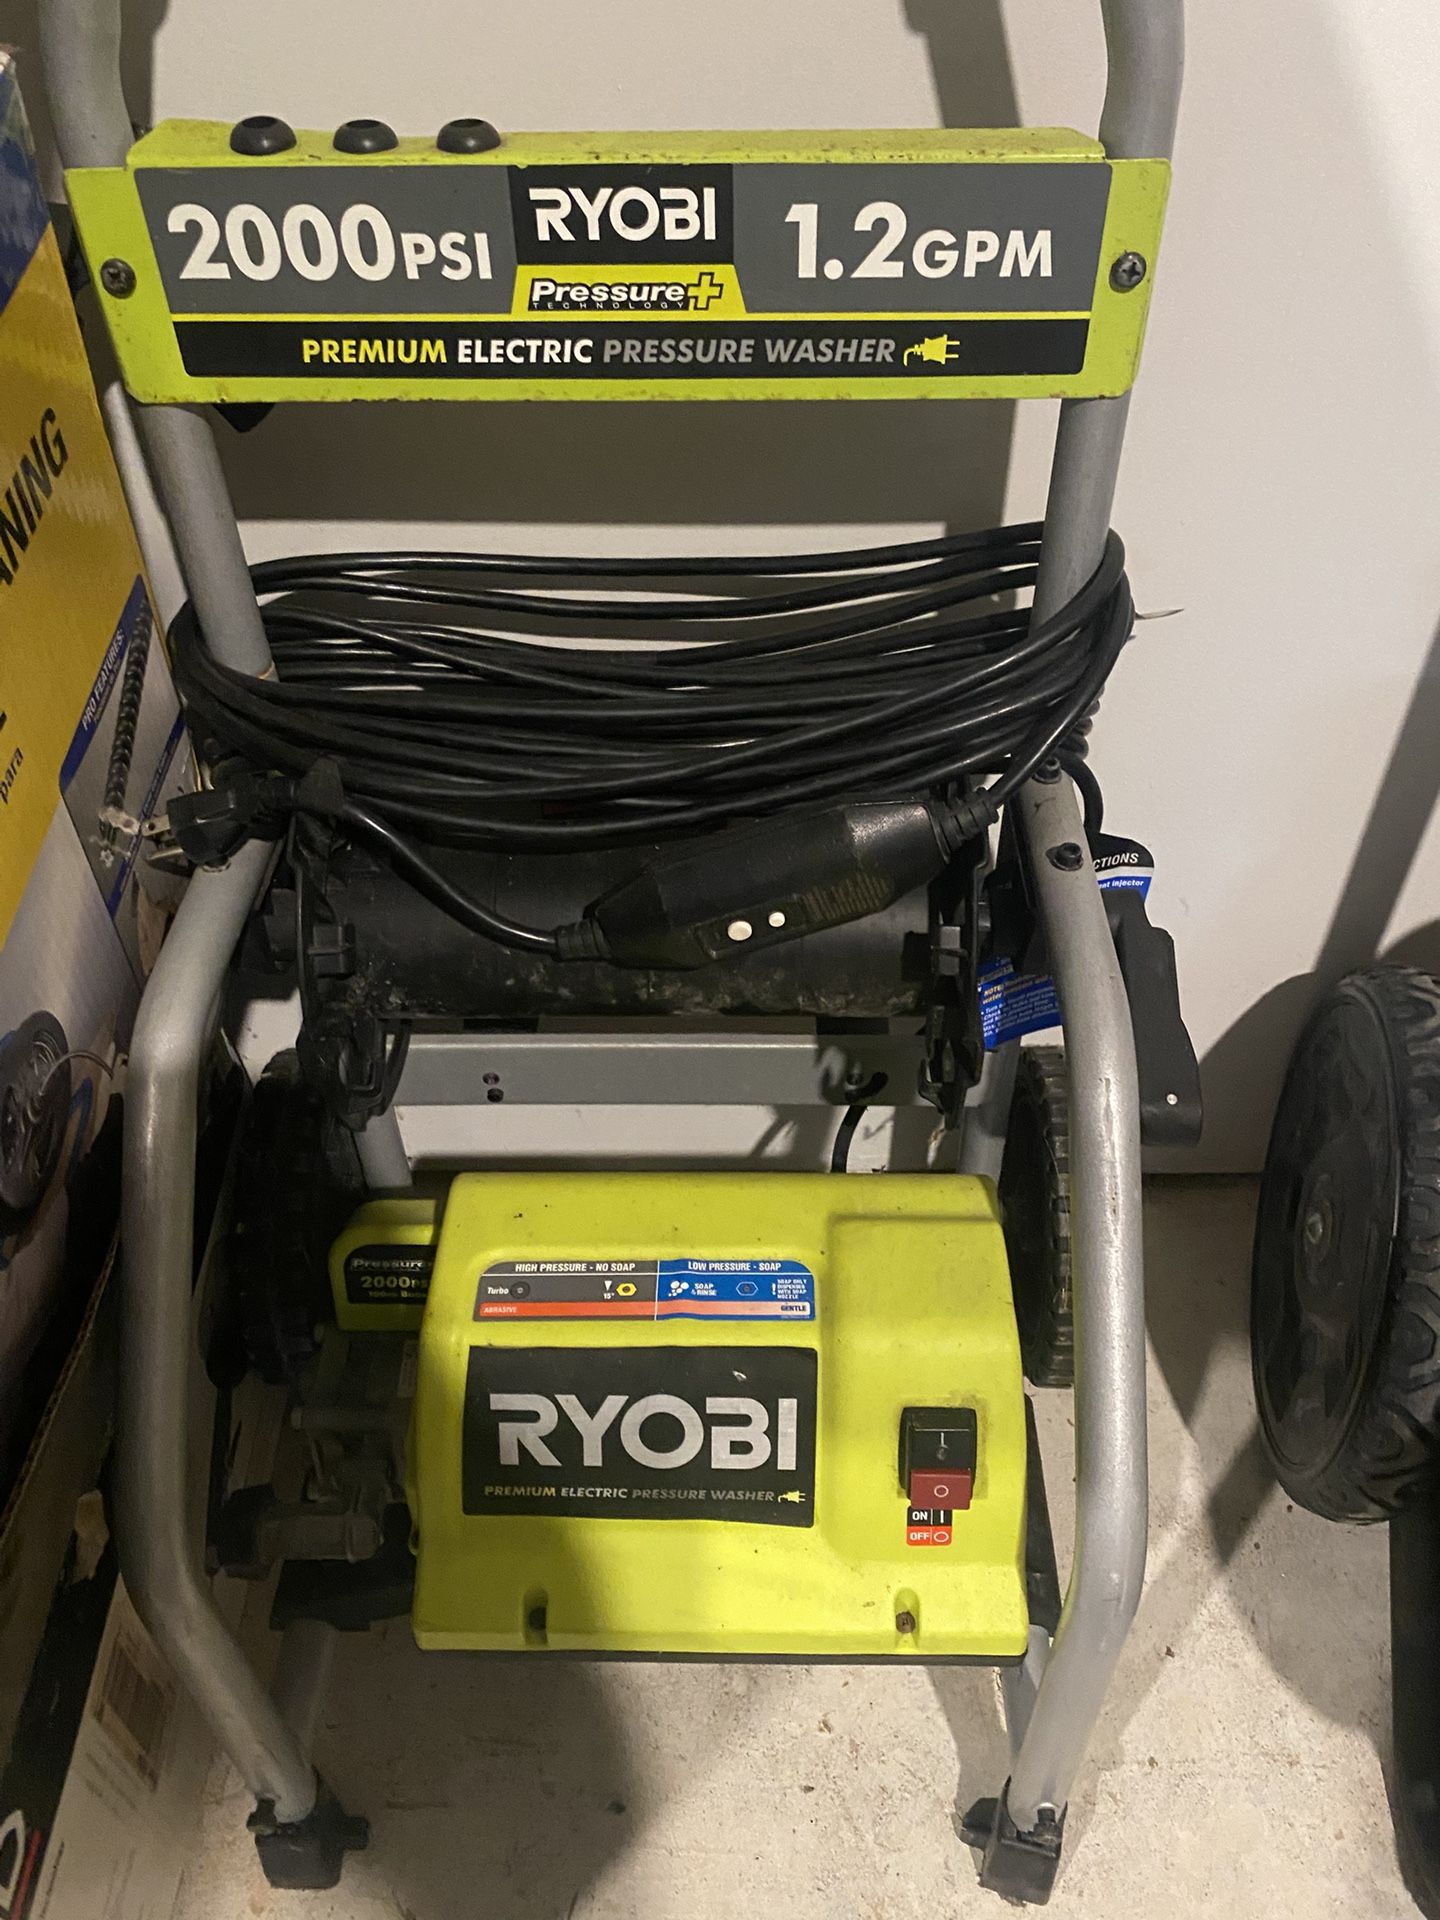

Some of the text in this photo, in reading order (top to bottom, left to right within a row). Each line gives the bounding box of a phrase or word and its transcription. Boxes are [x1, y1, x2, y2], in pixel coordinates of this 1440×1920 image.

[528, 186, 717, 241] RYOBI
[532, 302, 685, 310] TECHNOLOGY
[302, 338, 897, 364] PREMIUM ELECTRIC PRESSURE WASHER
[82, 698, 98, 731] PRO
[0, 747, 24, 805] para
[1111, 879, 1145, 888] injector
[515, 1263, 537, 1272] HIGH
[539, 1263, 587, 1272] PRESSURE
[595, 1263, 609, 1272] NO
[610, 1263, 636, 1272] SOAP
[688, 1261, 706, 1270] LOW
[708, 1262, 751, 1271] PRESSURE
[758, 1262, 782, 1271] SOAP
[487, 1287, 509, 1295] Turbo
[489, 1393, 798, 1471] RYOBI
[484, 1485, 774, 1502] PREMIUM ELECTRIC PRESSURE WASHER
[912, 1511, 928, 1521] ON
[910, 1532, 929, 1541] OFF
